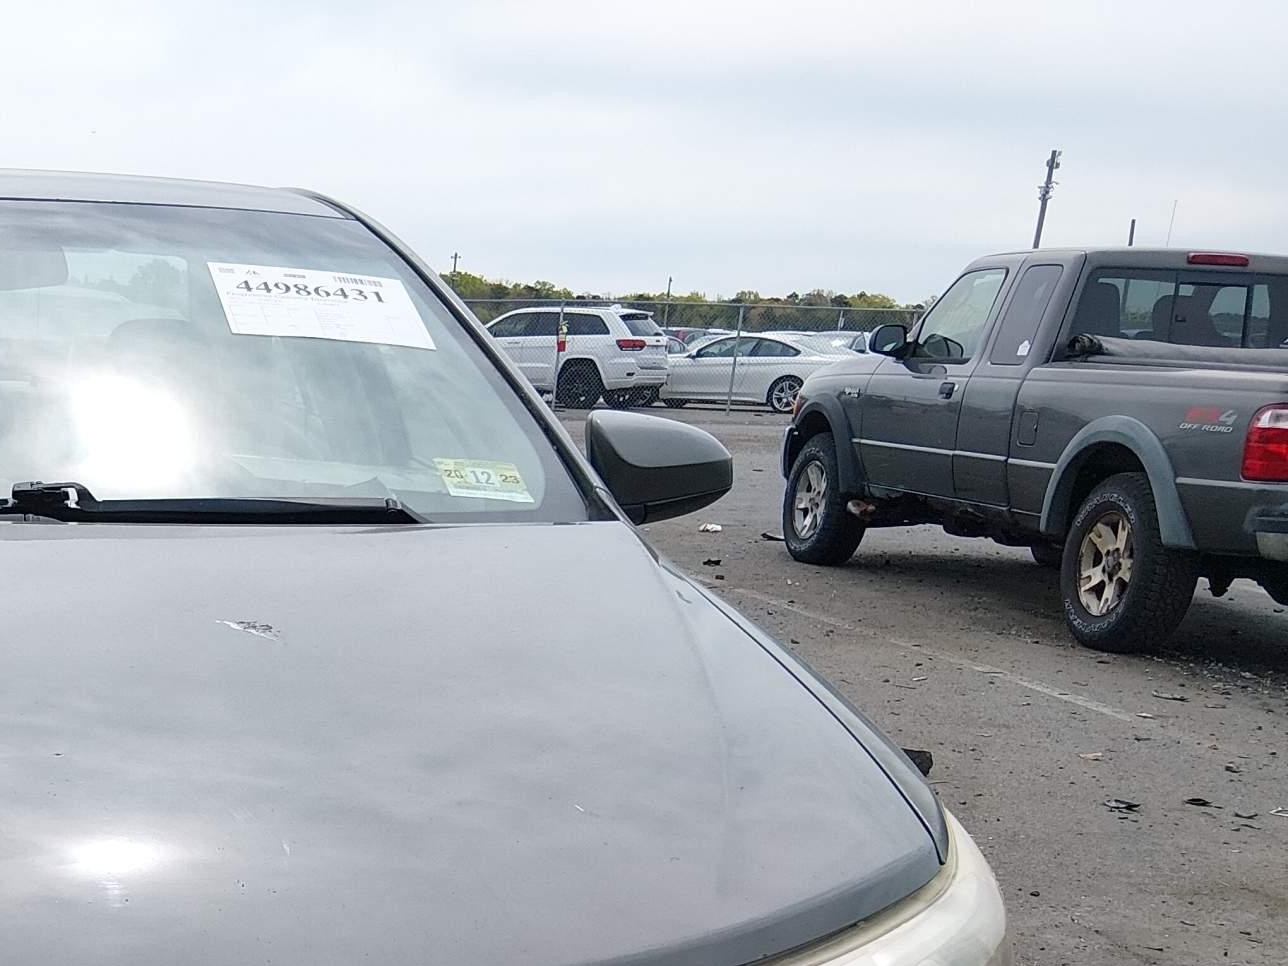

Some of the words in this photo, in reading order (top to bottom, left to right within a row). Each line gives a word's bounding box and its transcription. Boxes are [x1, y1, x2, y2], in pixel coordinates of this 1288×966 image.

[236, 279, 385, 303] 44986431
[1179, 422, 1200, 430] OFF
[1201, 424, 1233, 433] ROAD
[470, 470, 496, 485] 12
[499, 474, 520, 485] 23
